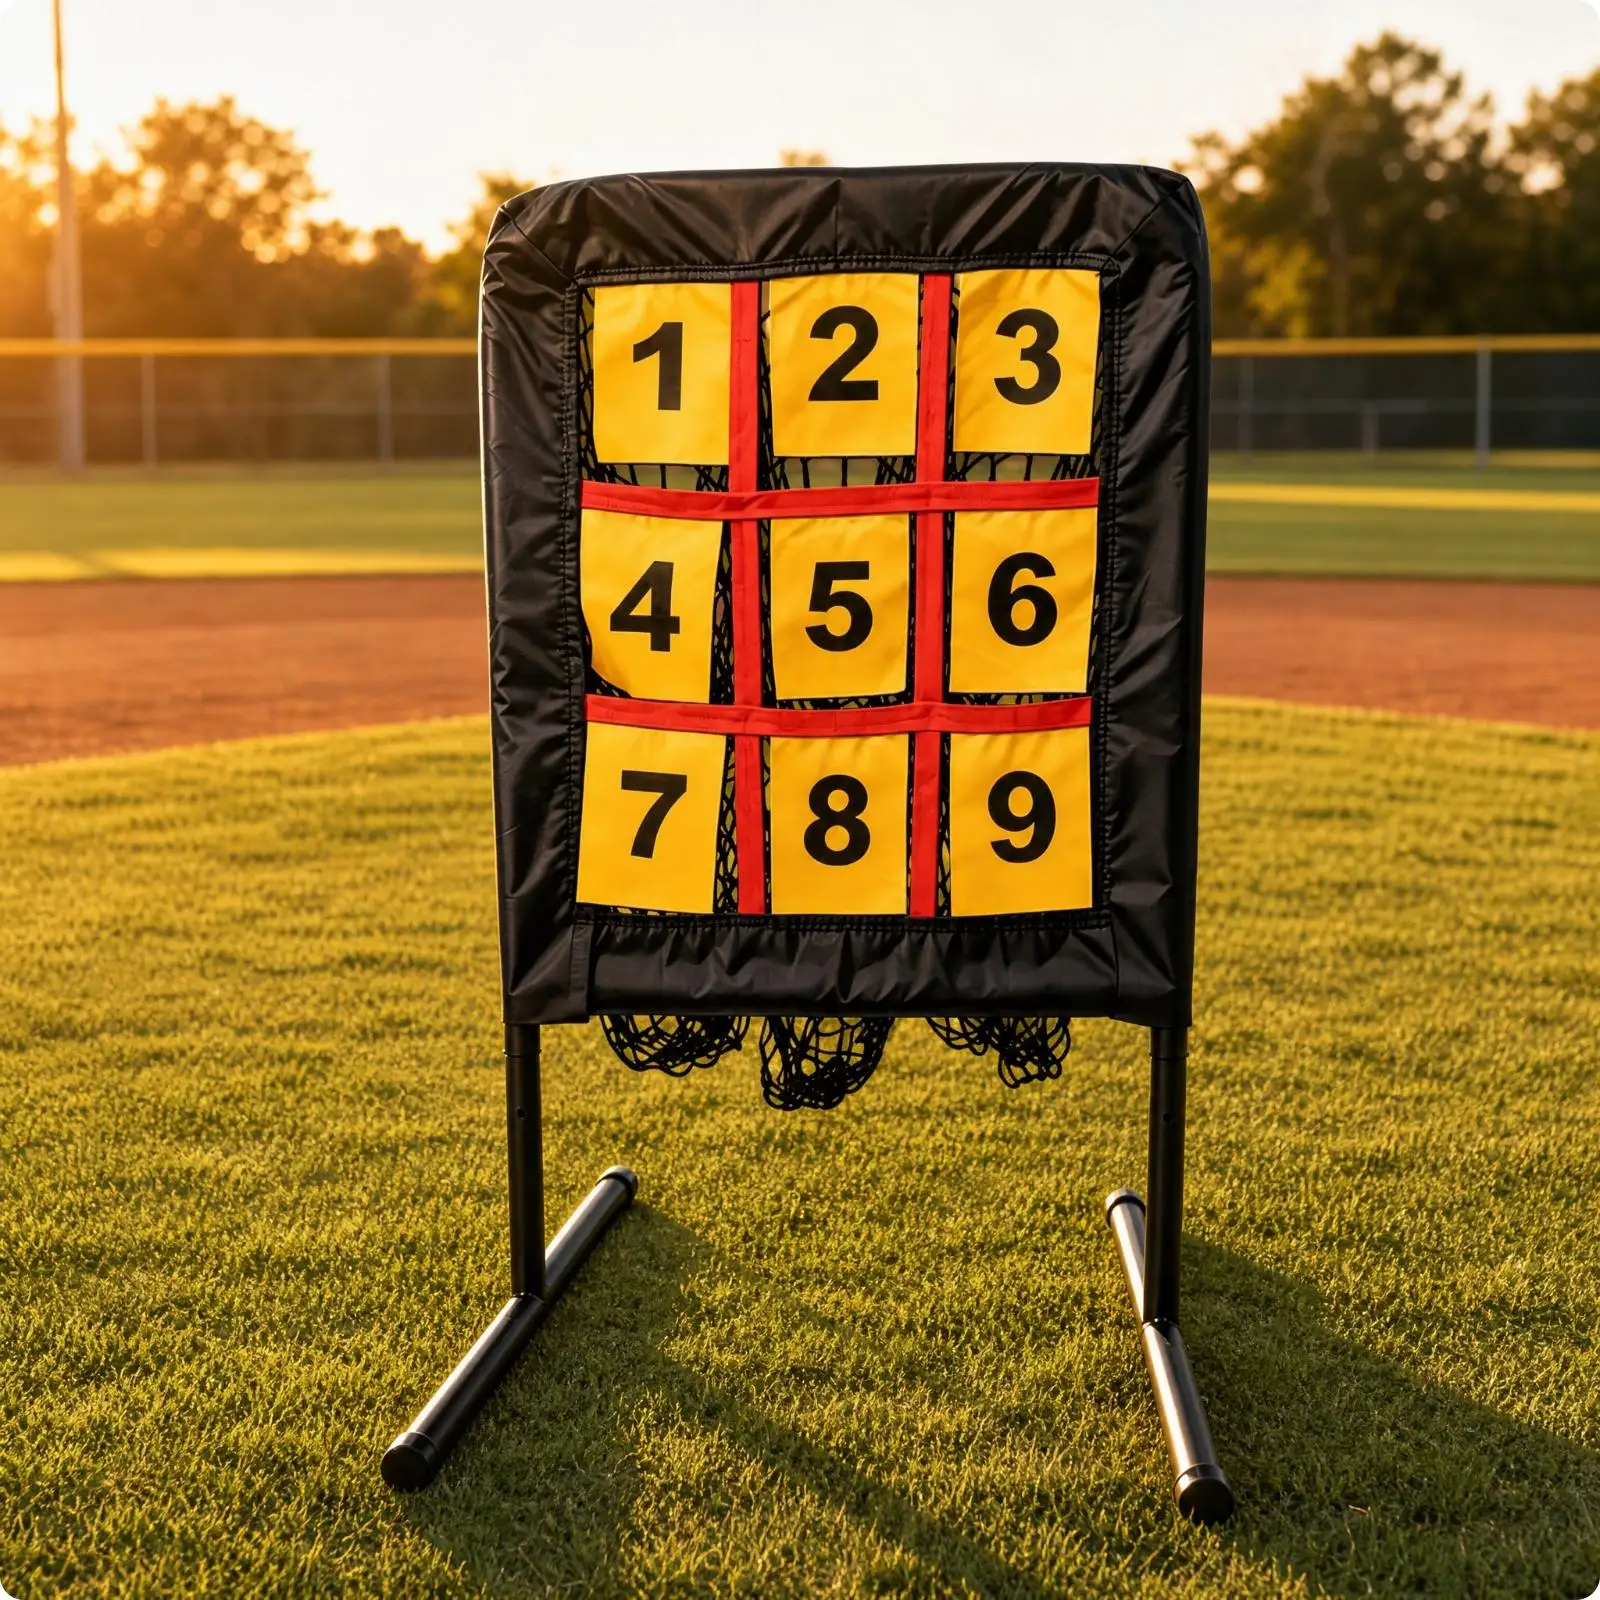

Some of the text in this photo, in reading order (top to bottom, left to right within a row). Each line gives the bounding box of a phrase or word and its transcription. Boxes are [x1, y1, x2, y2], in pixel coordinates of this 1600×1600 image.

[633, 322, 684, 411] 1
[809, 306, 879, 402] 2
[995, 309, 1061, 405] 3
[610, 561, 680, 652] 4
[805, 561, 873, 652] 5
[988, 553, 1058, 647] 6
[621, 771, 687, 859] 7
[804, 775, 871, 866] 8
[988, 771, 1056, 864] 9
